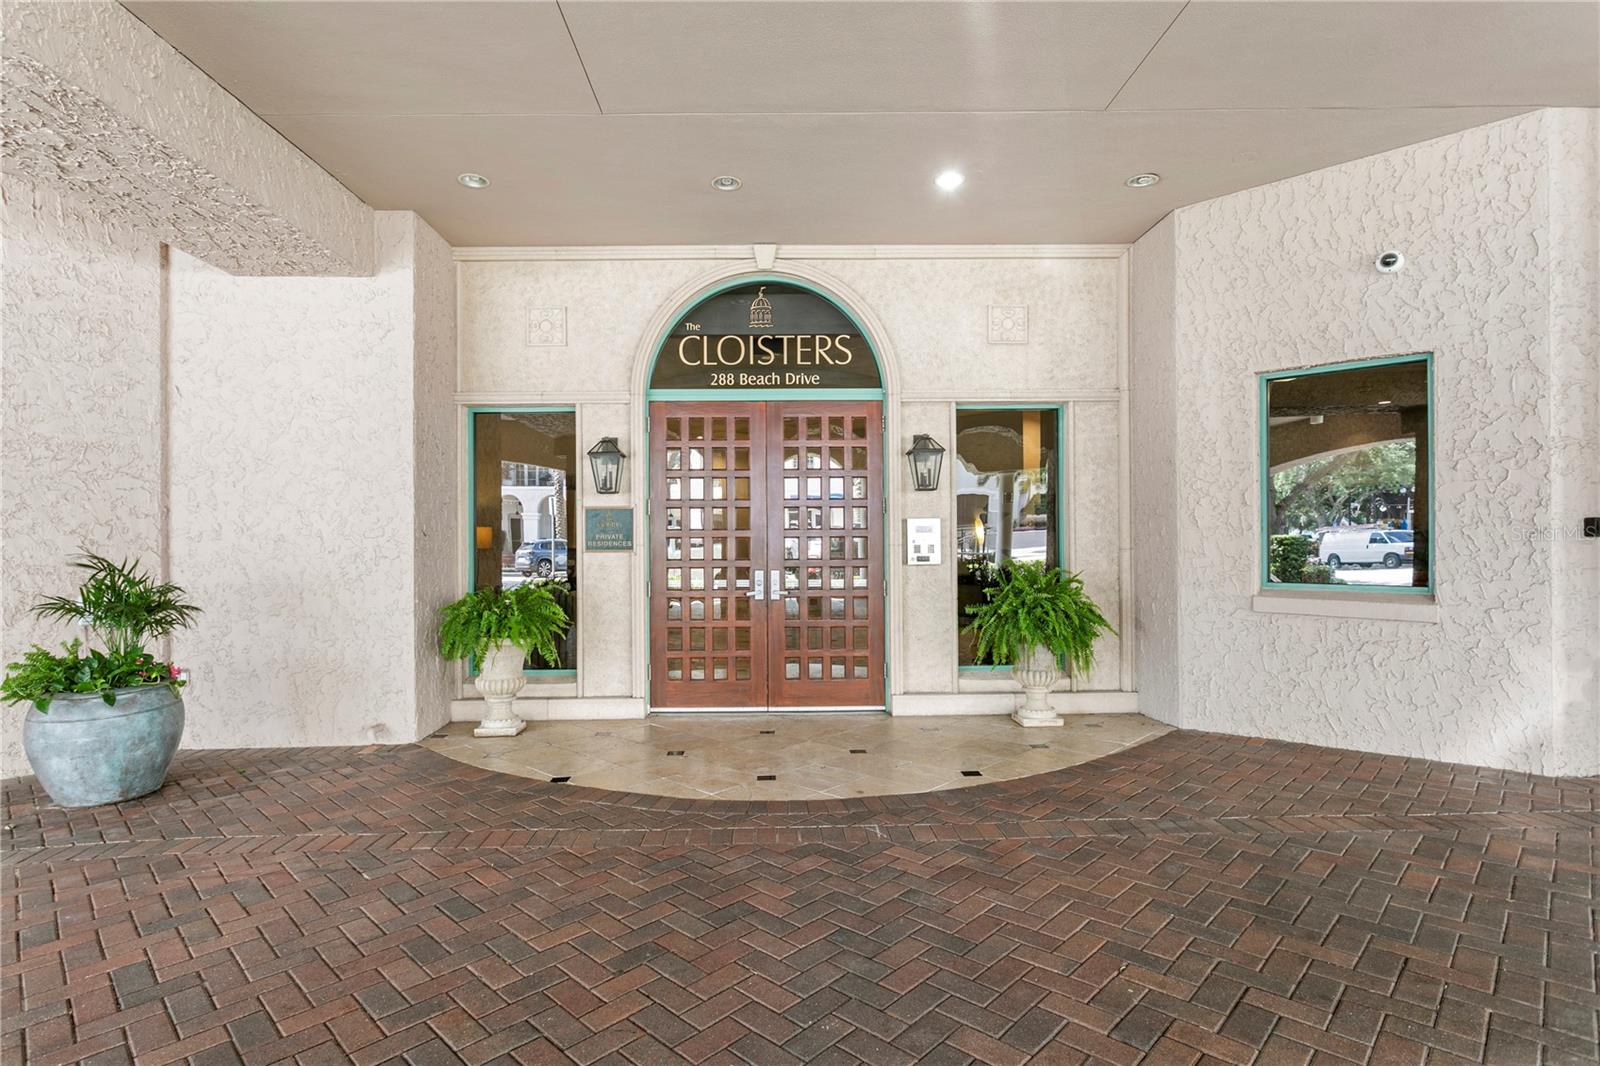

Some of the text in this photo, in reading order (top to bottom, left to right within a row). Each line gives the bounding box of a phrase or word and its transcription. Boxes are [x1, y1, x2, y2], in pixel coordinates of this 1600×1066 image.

[685, 322, 701, 331] The
[678, 335, 853, 366] CLOISTERS
[710, 372, 820, 386] 288 Beach Drive
